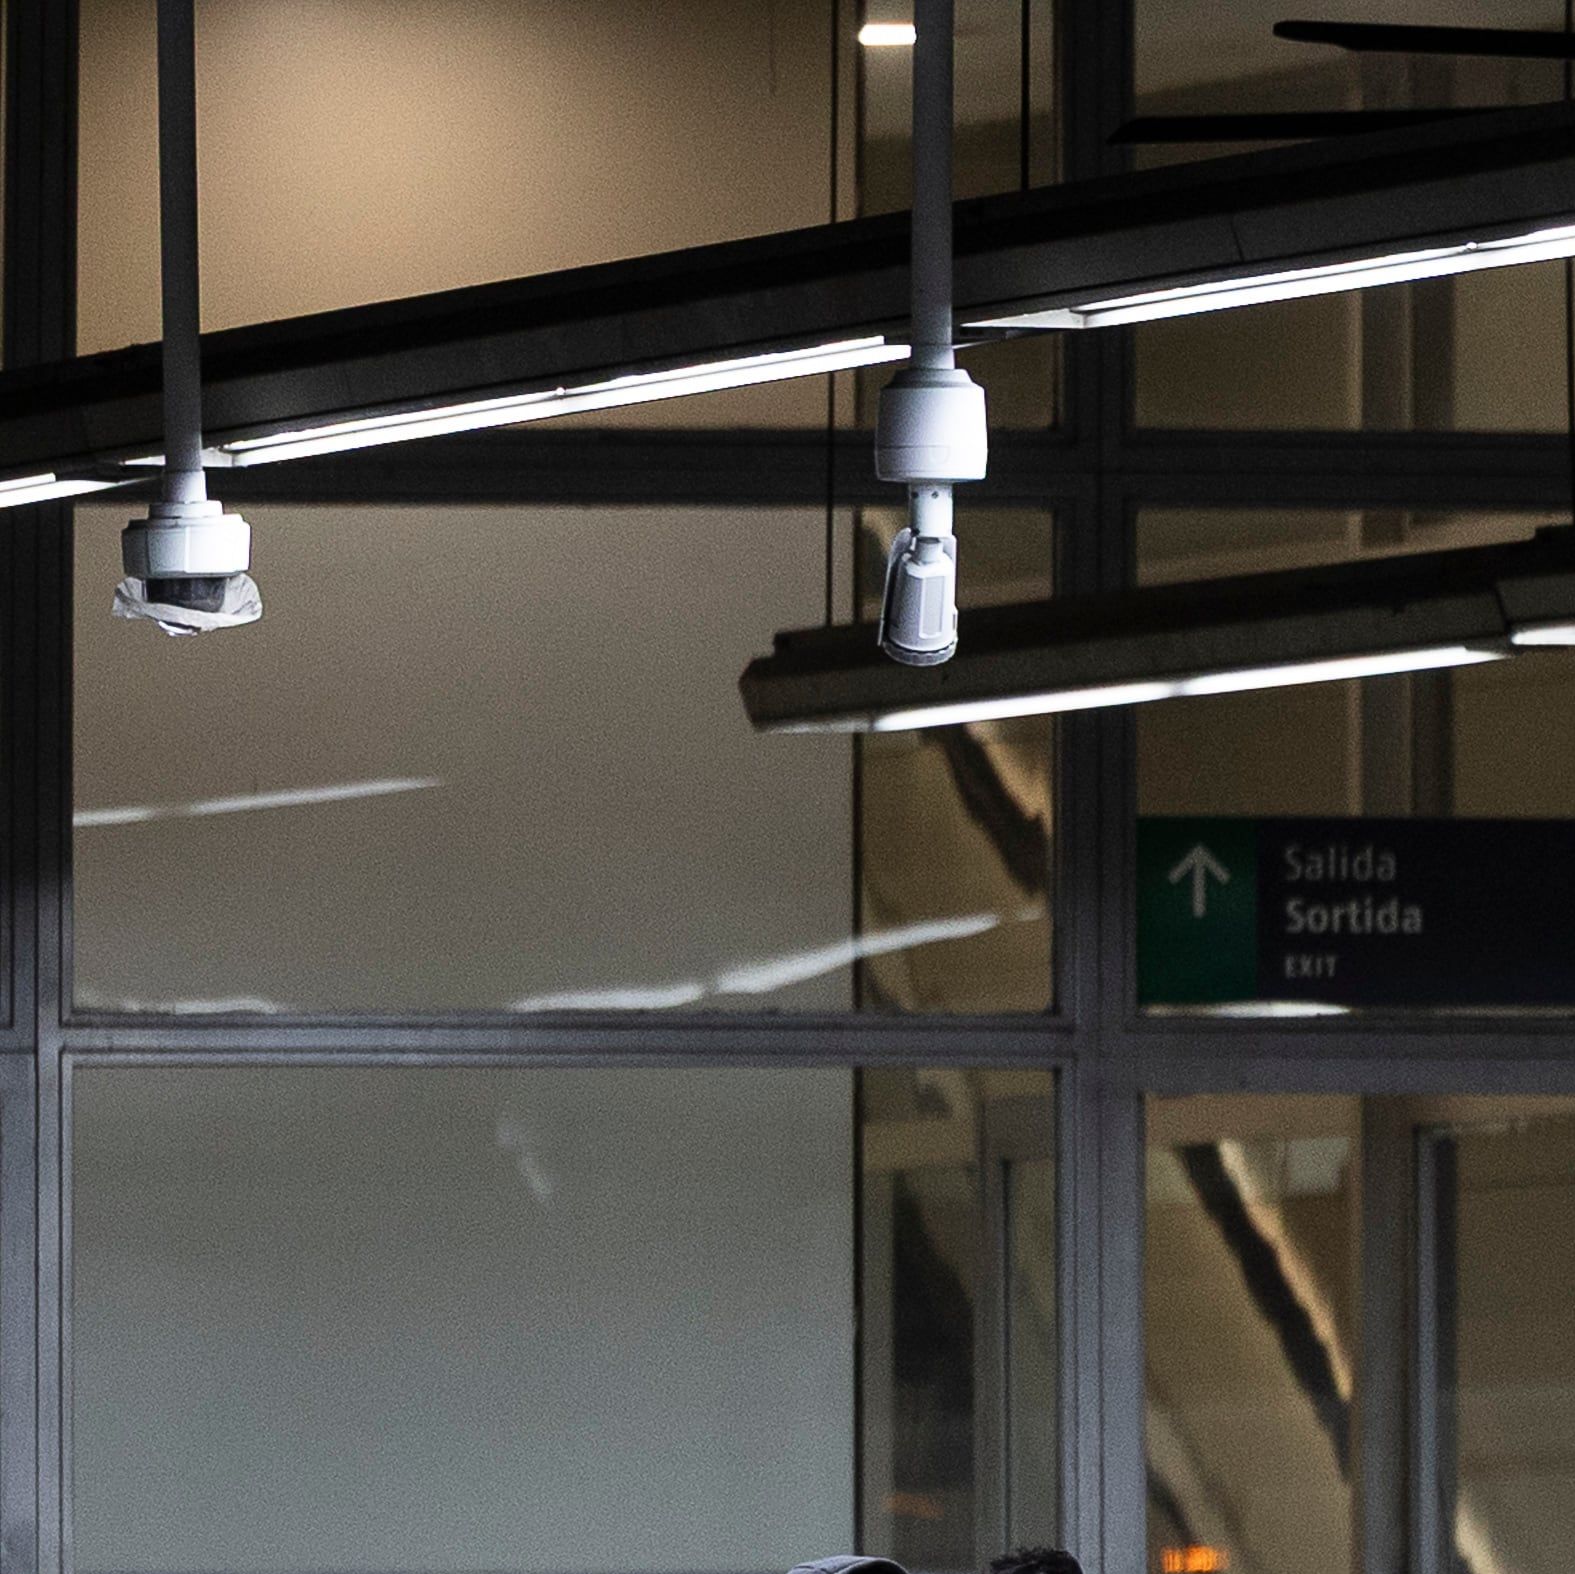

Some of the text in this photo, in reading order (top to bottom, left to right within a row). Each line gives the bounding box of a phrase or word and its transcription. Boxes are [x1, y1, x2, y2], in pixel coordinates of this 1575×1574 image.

[1284, 845, 1397, 881] Salida
[1285, 897, 1423, 934] Sortida
[1285, 954, 1337, 978] EXIT
